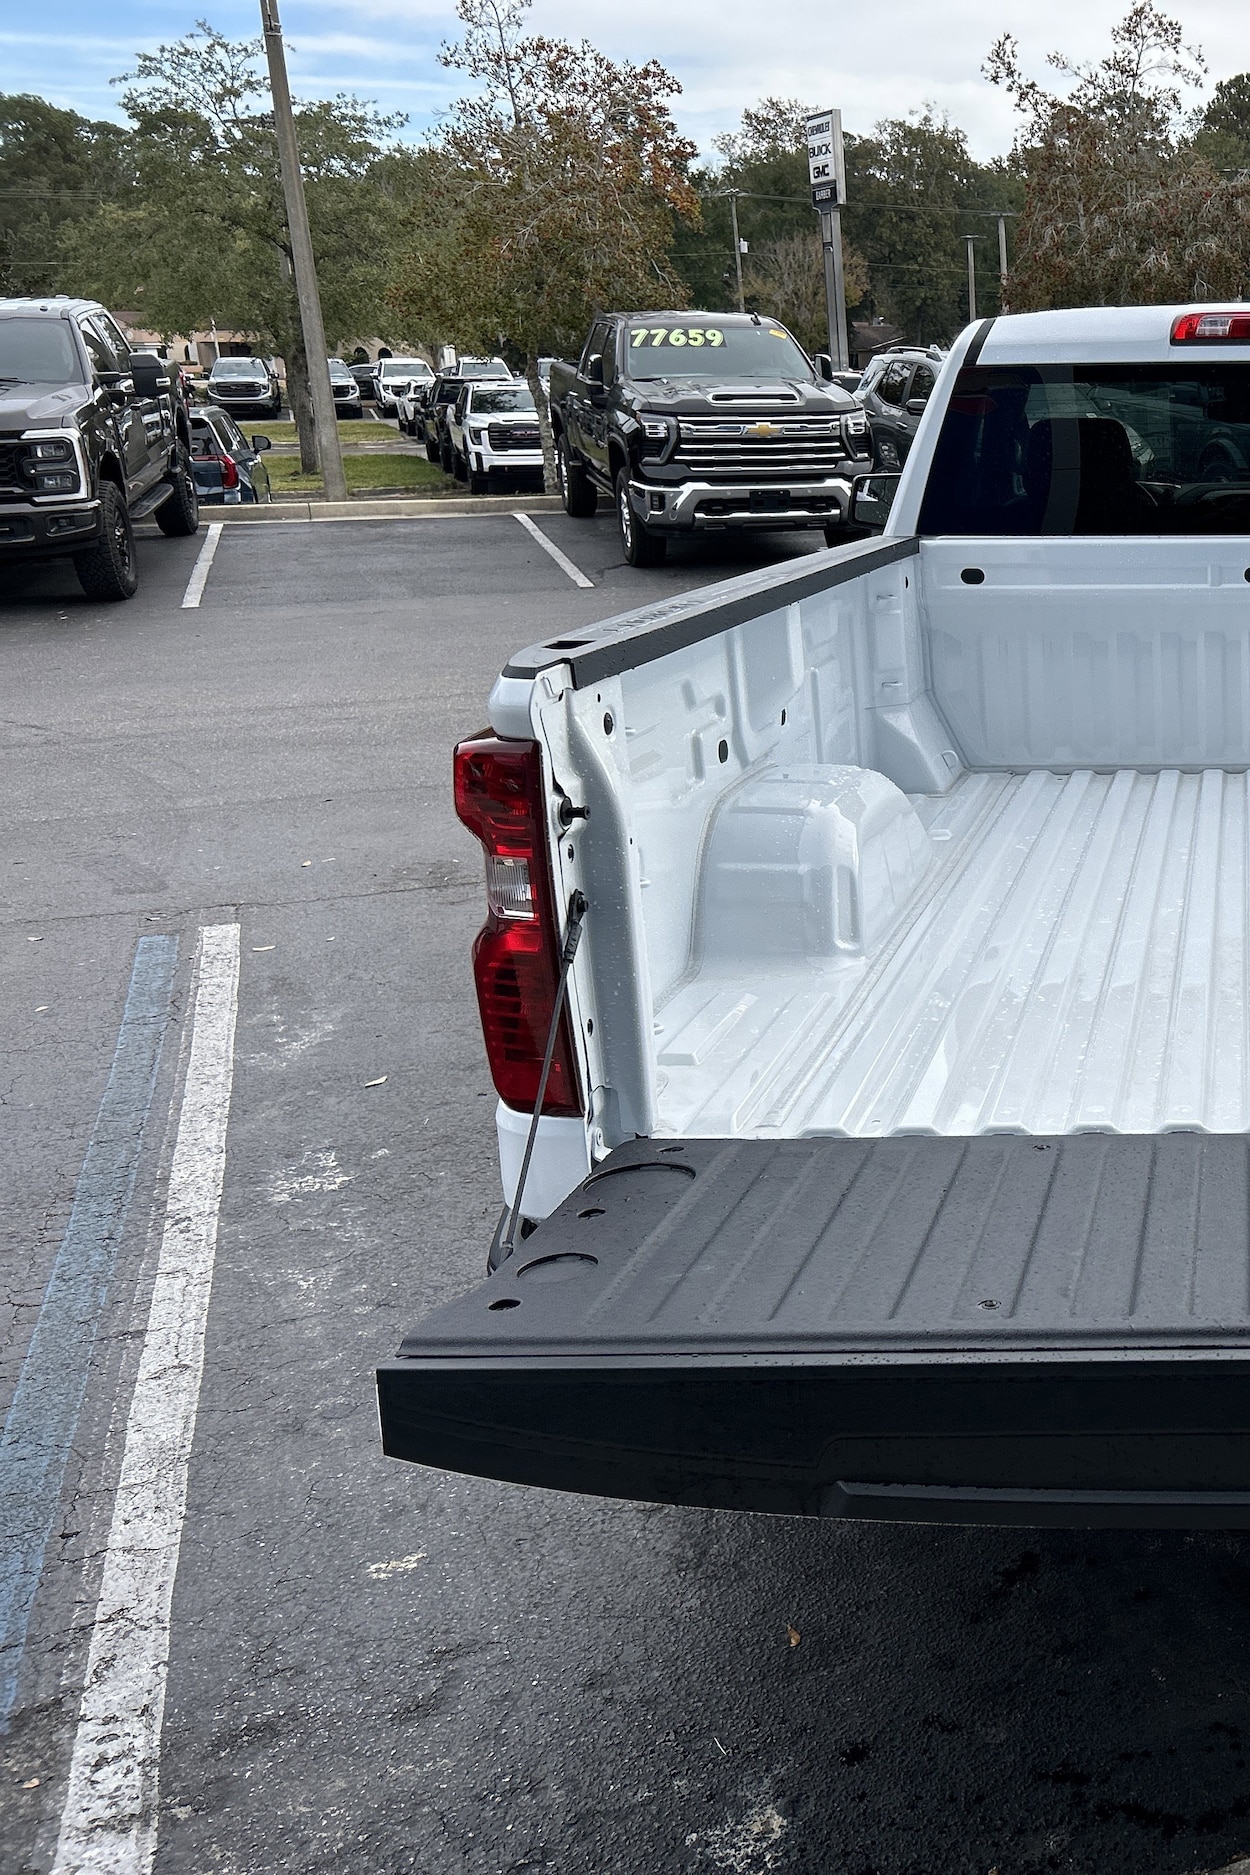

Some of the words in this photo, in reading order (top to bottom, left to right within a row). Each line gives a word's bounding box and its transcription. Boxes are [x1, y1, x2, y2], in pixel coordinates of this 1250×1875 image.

[809, 142, 832, 158] BUICK
[813, 164, 829, 179] GMC
[630, 328, 724, 347] 77659
